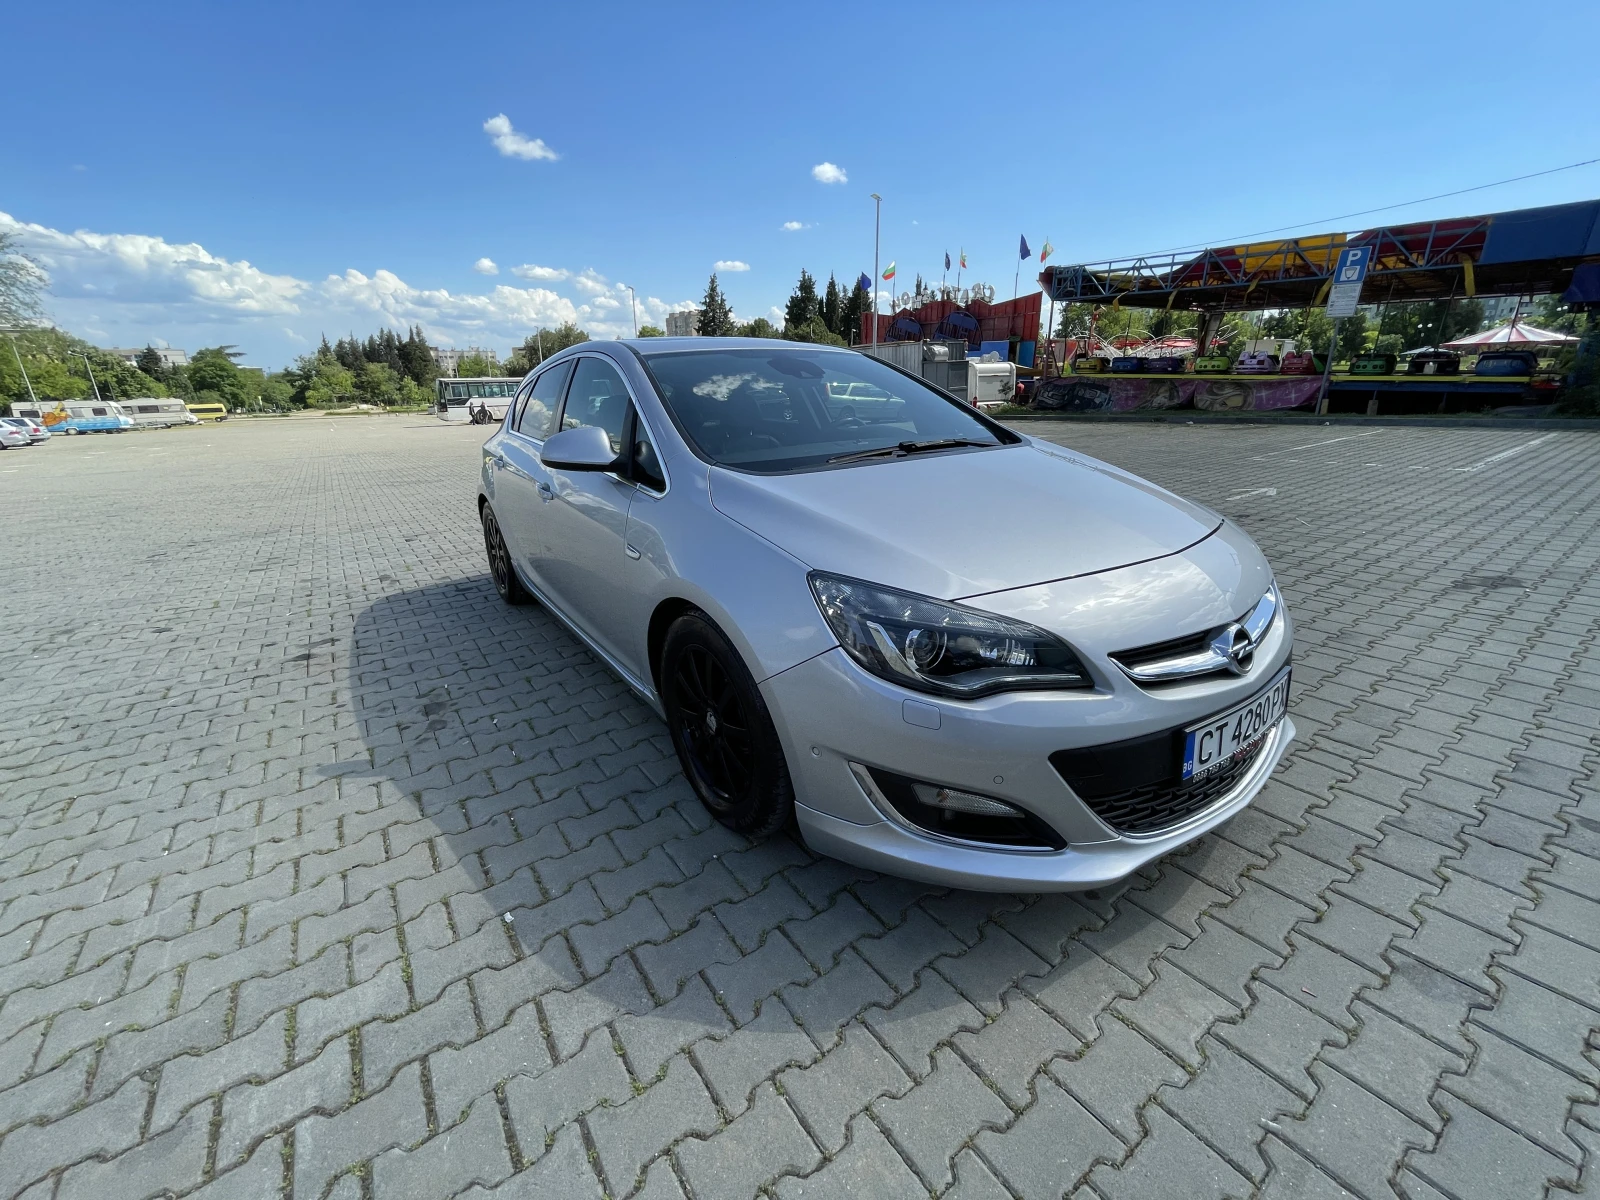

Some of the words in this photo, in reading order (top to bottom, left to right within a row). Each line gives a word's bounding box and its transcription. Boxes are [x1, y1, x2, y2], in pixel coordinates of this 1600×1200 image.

[1346, 250, 1362, 266] P
[1198, 722, 1228, 765] CT
[1231, 695, 1270, 746] 4280
[1270, 679, 1287, 718] PX
